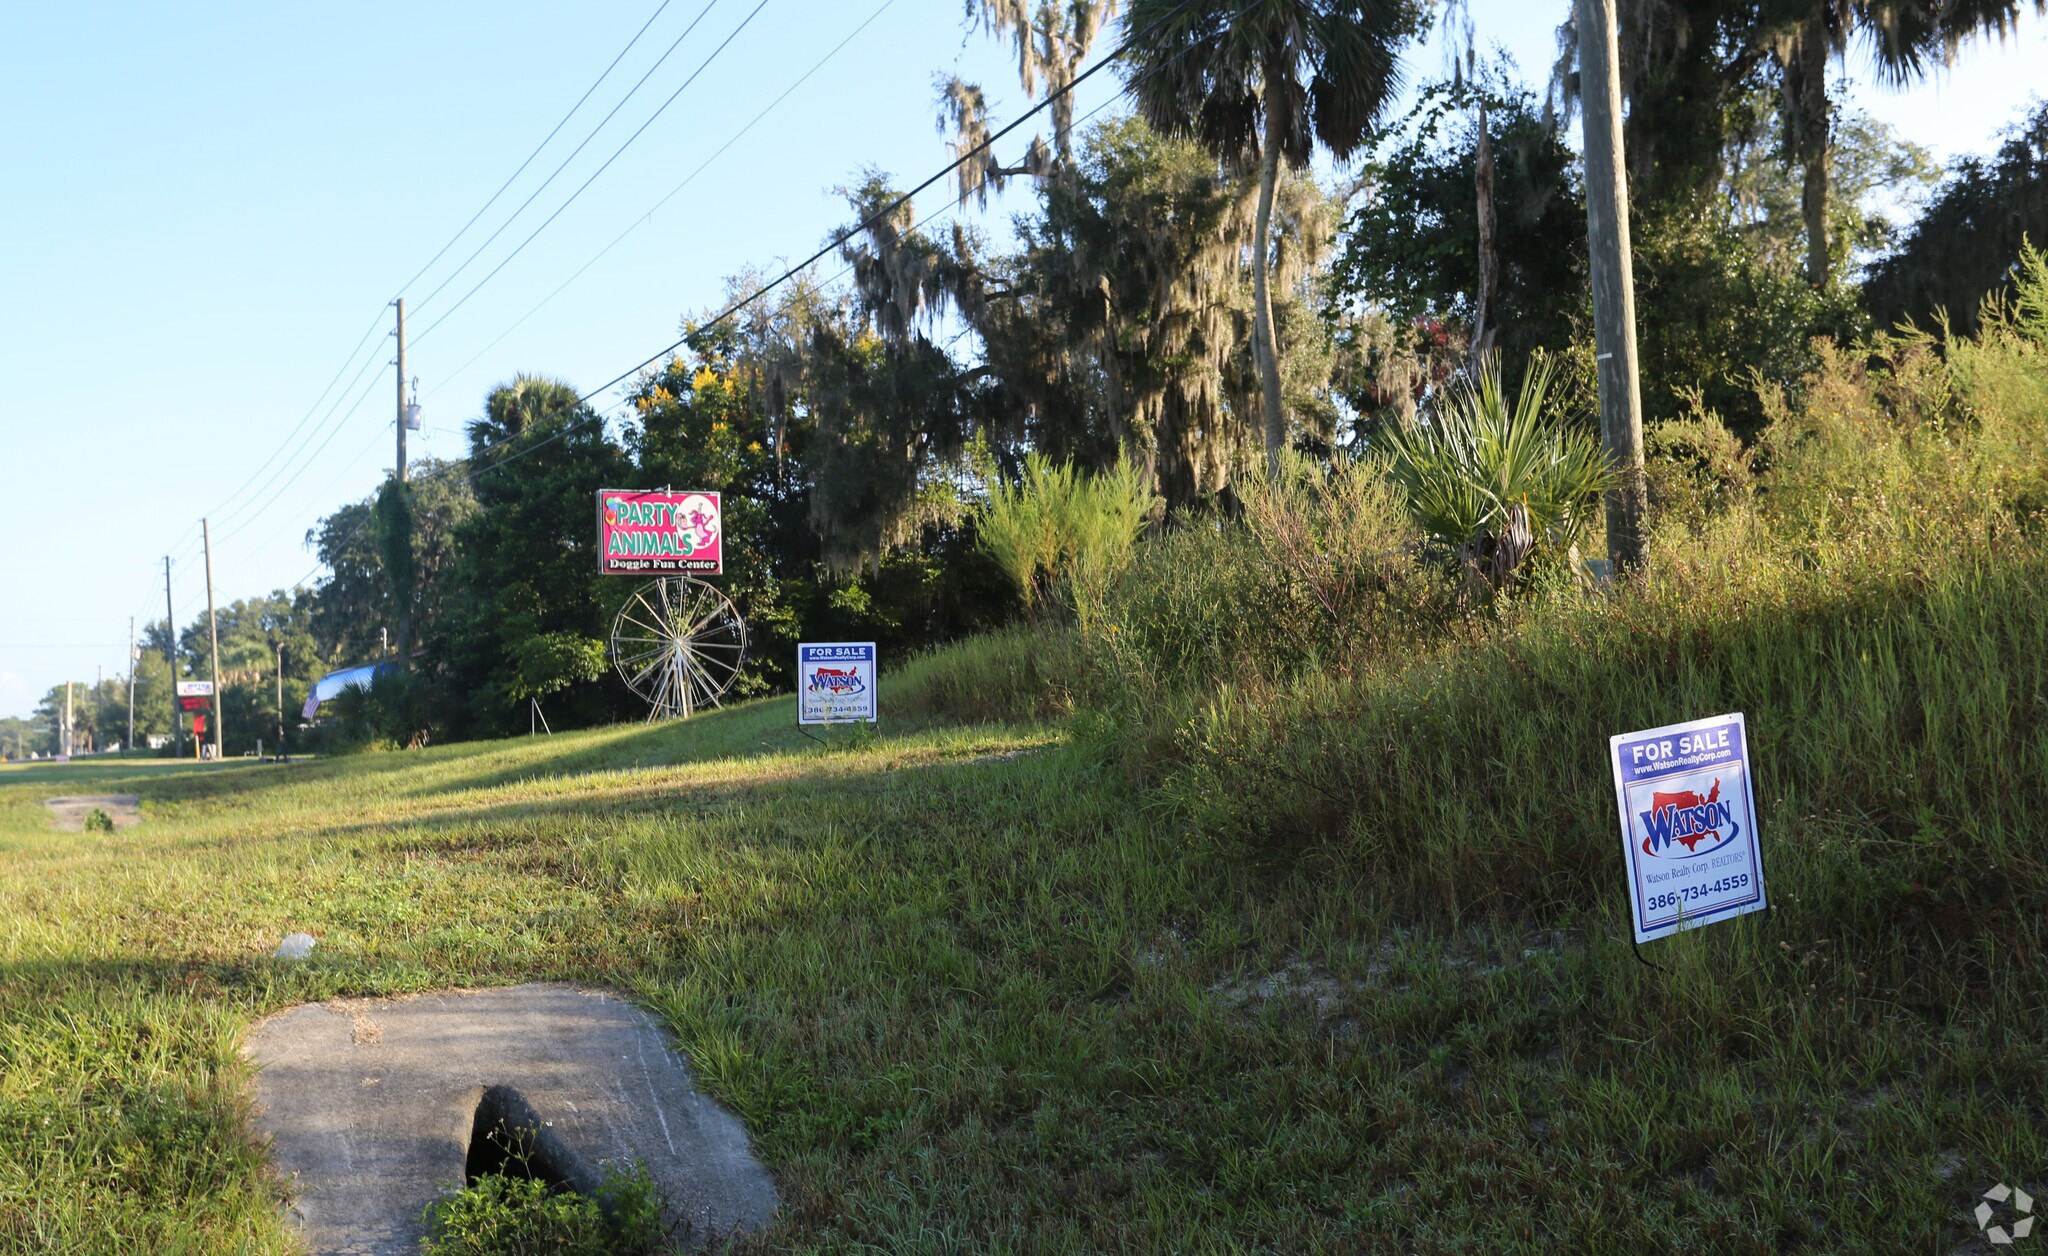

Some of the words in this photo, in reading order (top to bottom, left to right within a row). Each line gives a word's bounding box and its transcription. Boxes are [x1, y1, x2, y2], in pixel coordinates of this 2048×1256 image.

[616, 502, 678, 526] PARTY
[608, 531, 694, 556] ANIMALS
[610, 559, 650, 570] Doggie
[653, 559, 675, 569] Fun
[678, 559, 716, 569] Center
[809, 648, 832, 656] FOR
[836, 647, 866, 655] SALE
[808, 705, 868, 714] 386734-4559
[1632, 740, 1673, 764] FOR
[1679, 728, 1730, 754] SALE
[1634, 749, 1731, 775] www.WatsonRealtyCorp.com
[1646, 871, 1671, 884] Watson
[1671, 864, 1691, 879] Realty
[1692, 862, 1710, 874] Corp.
[1648, 873, 1748, 911] 386-734-4559
